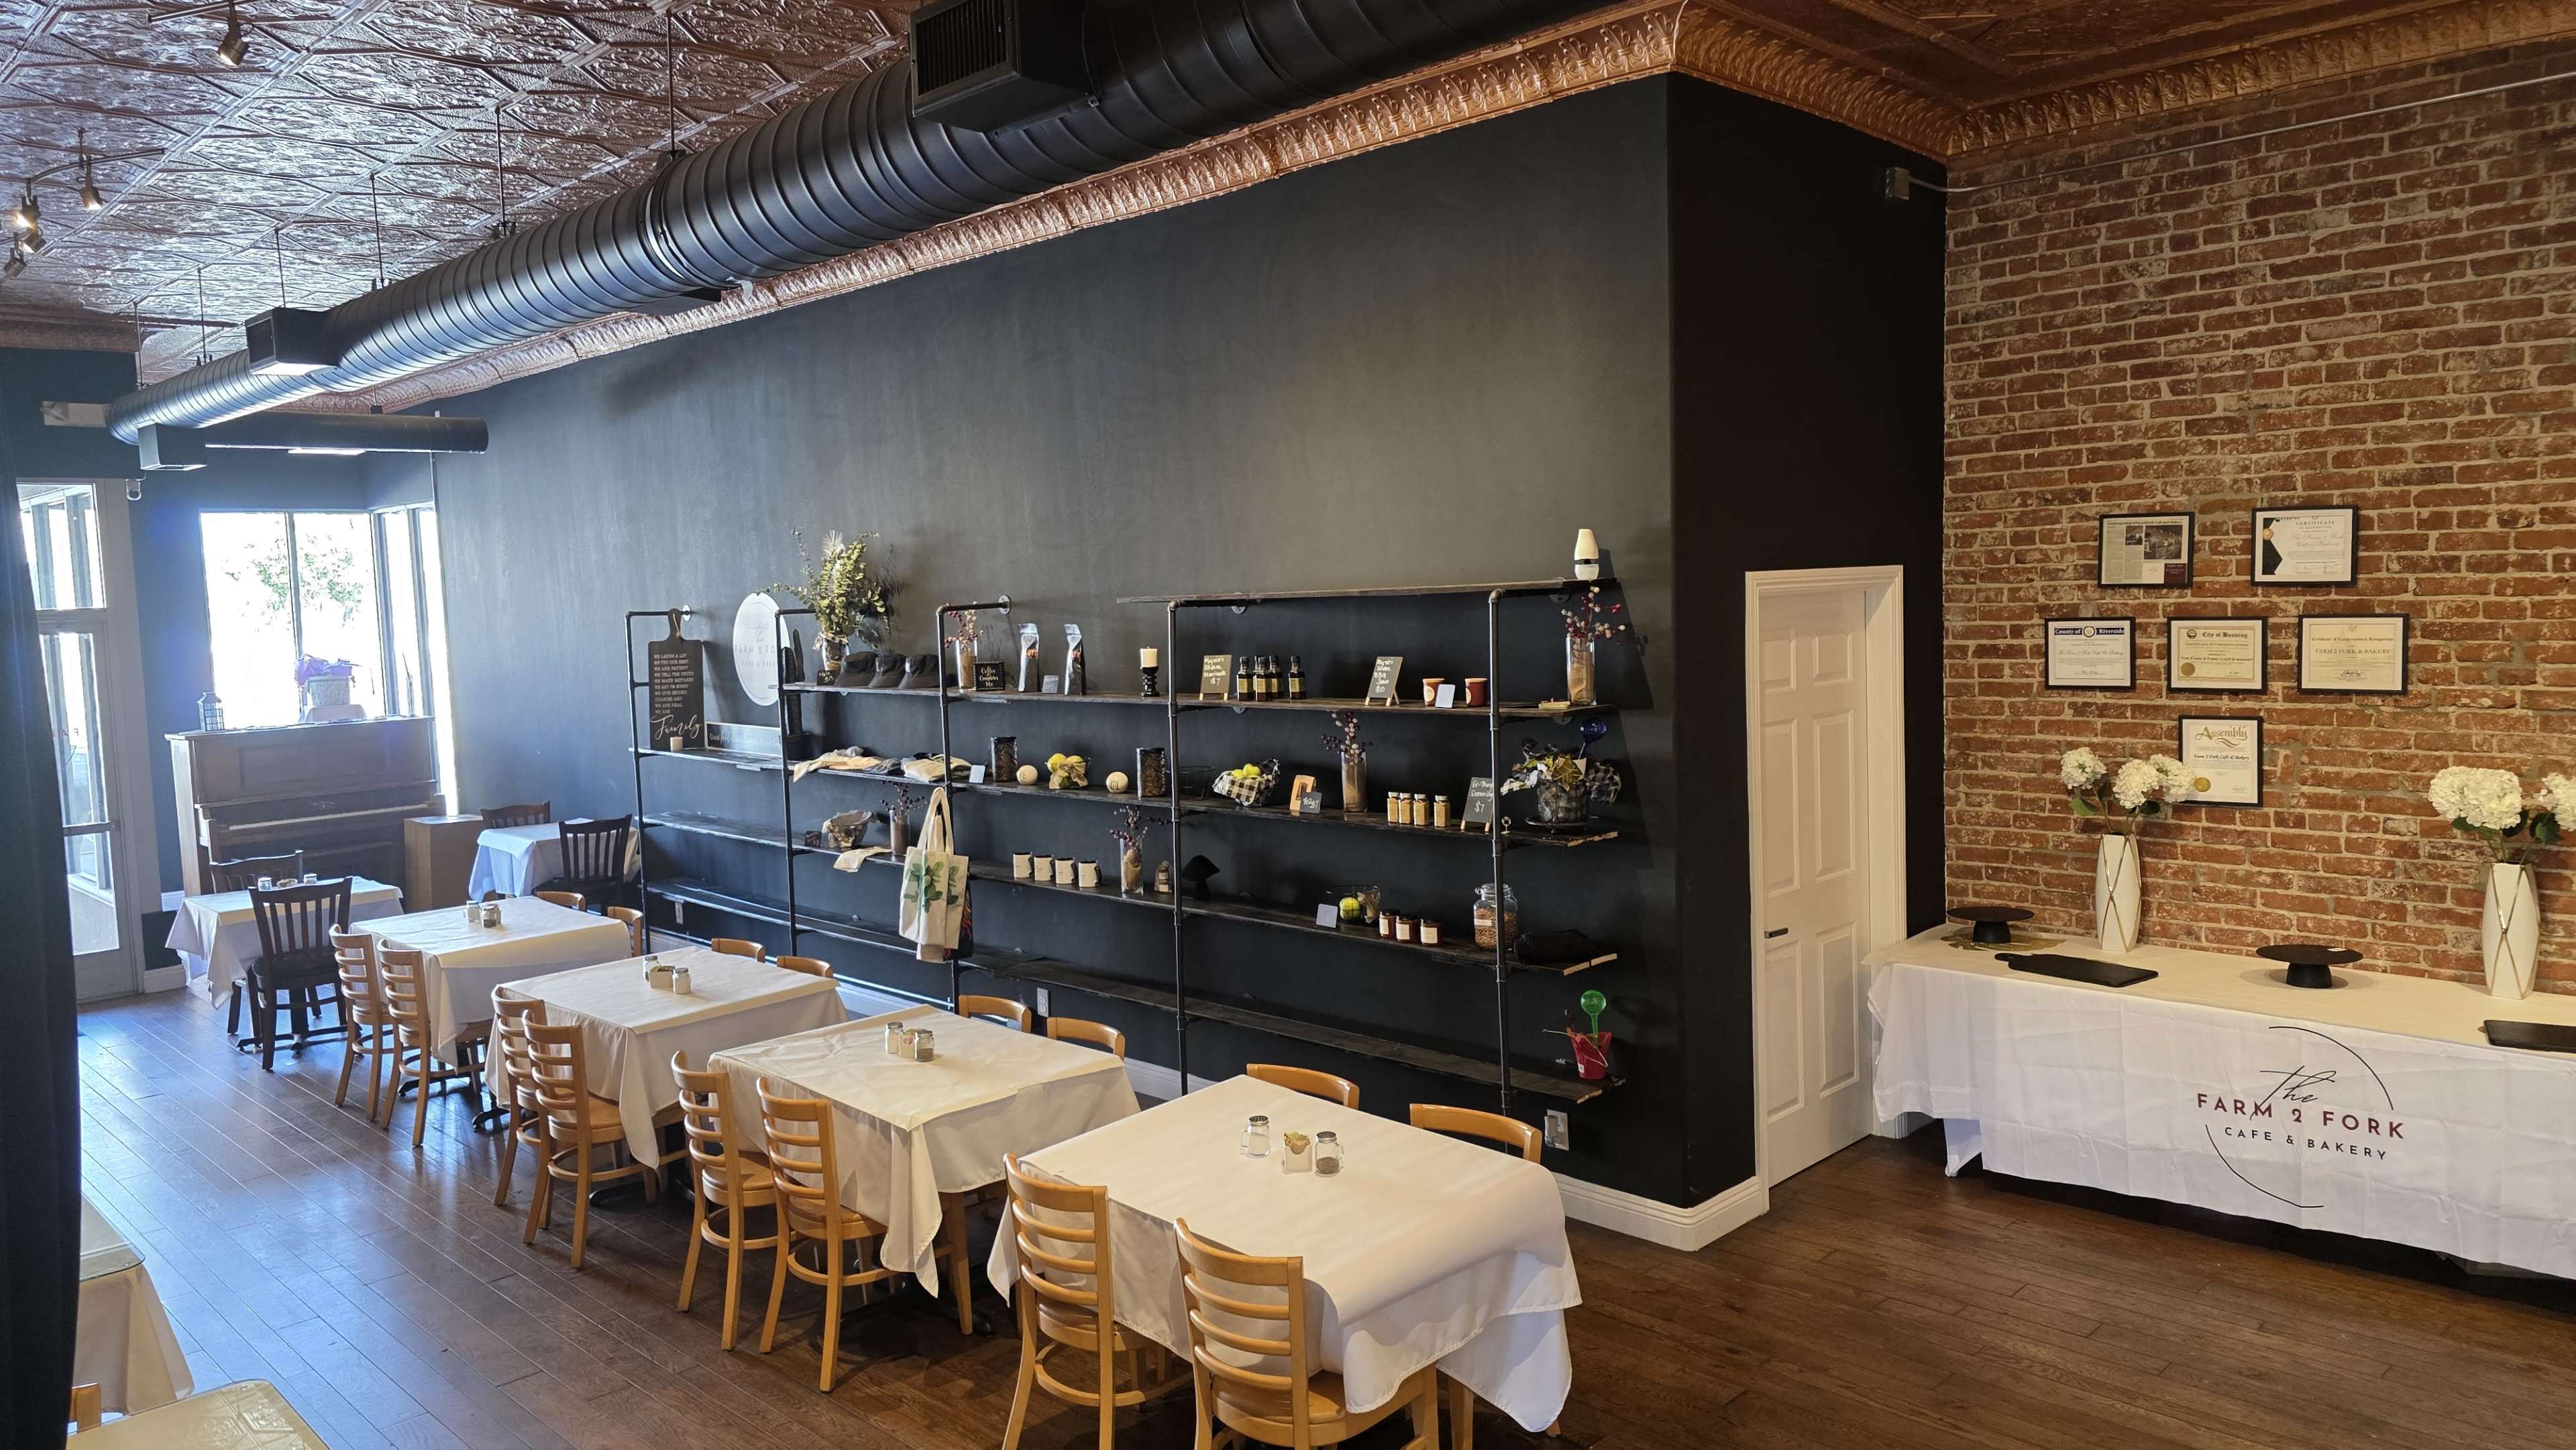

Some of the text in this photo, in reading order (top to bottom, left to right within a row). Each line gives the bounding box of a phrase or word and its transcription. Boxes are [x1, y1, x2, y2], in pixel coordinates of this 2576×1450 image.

[981, 665, 996, 677] Coffee
[1375, 685, 1385, 693] $10
[2194, 726, 2249, 741] Assembly
[1474, 799, 1485, 814] $7
[2197, 1093, 2404, 1139] FARM 2 FORK
[2224, 1127, 2386, 1160] CAFE & BAKERY
